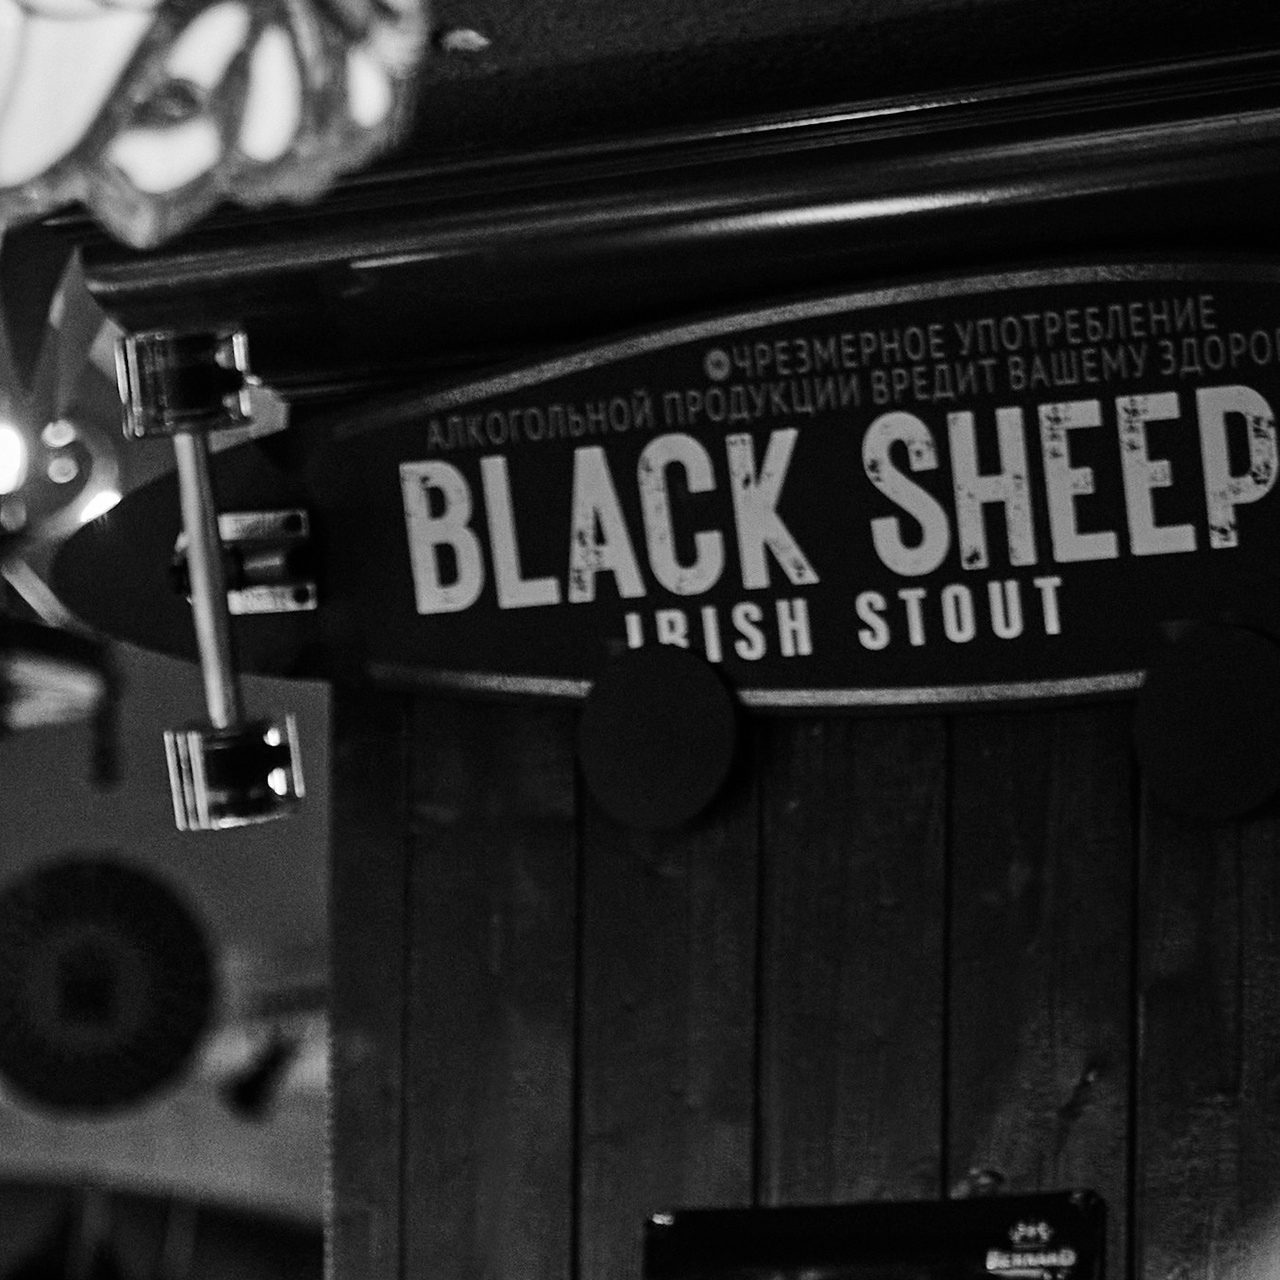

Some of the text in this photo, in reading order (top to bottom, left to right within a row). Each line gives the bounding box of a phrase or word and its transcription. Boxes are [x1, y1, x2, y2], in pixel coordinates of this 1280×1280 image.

[732, 294, 1218, 379] ЧРЕЗМЕРНОЕ УПОТРЕБЛЕНИЕ
[426, 328, 1280, 451] АЛКОГОЛЬНОЙ ПРОДУКЦИИ ВРЕДИТ ВАШЕМУ ЗДОРО
[399, 384, 1280, 615] BLACK SHEEP
[624, 576, 1063, 664] IRISH STOUT
